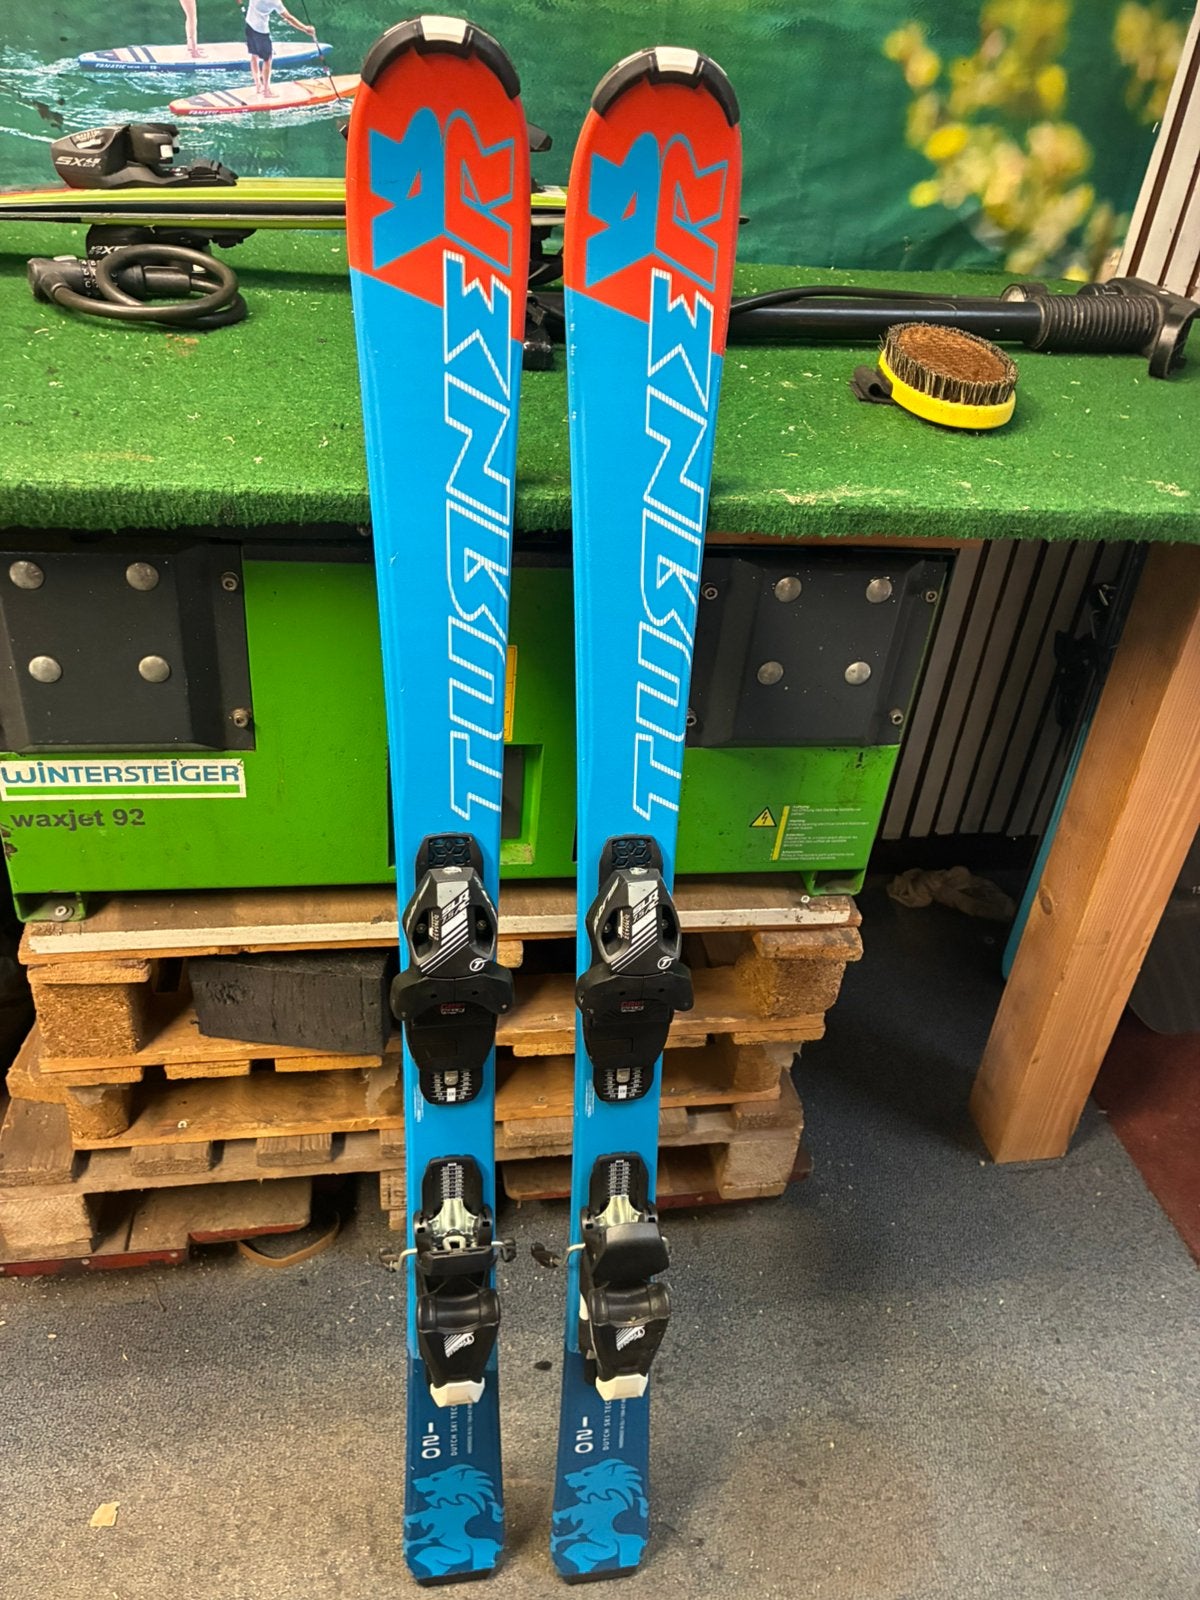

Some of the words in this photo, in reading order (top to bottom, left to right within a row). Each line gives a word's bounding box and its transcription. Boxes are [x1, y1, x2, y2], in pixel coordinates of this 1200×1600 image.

[10, 810, 105, 831] waxjet
[113, 809, 146, 826] 92
[450, 1419, 458, 1432] SKI
[603, 1414, 611, 1428] SKI
[450, 1433, 458, 1456] DUTCH
[602, 1427, 611, 1451] DUTCH
